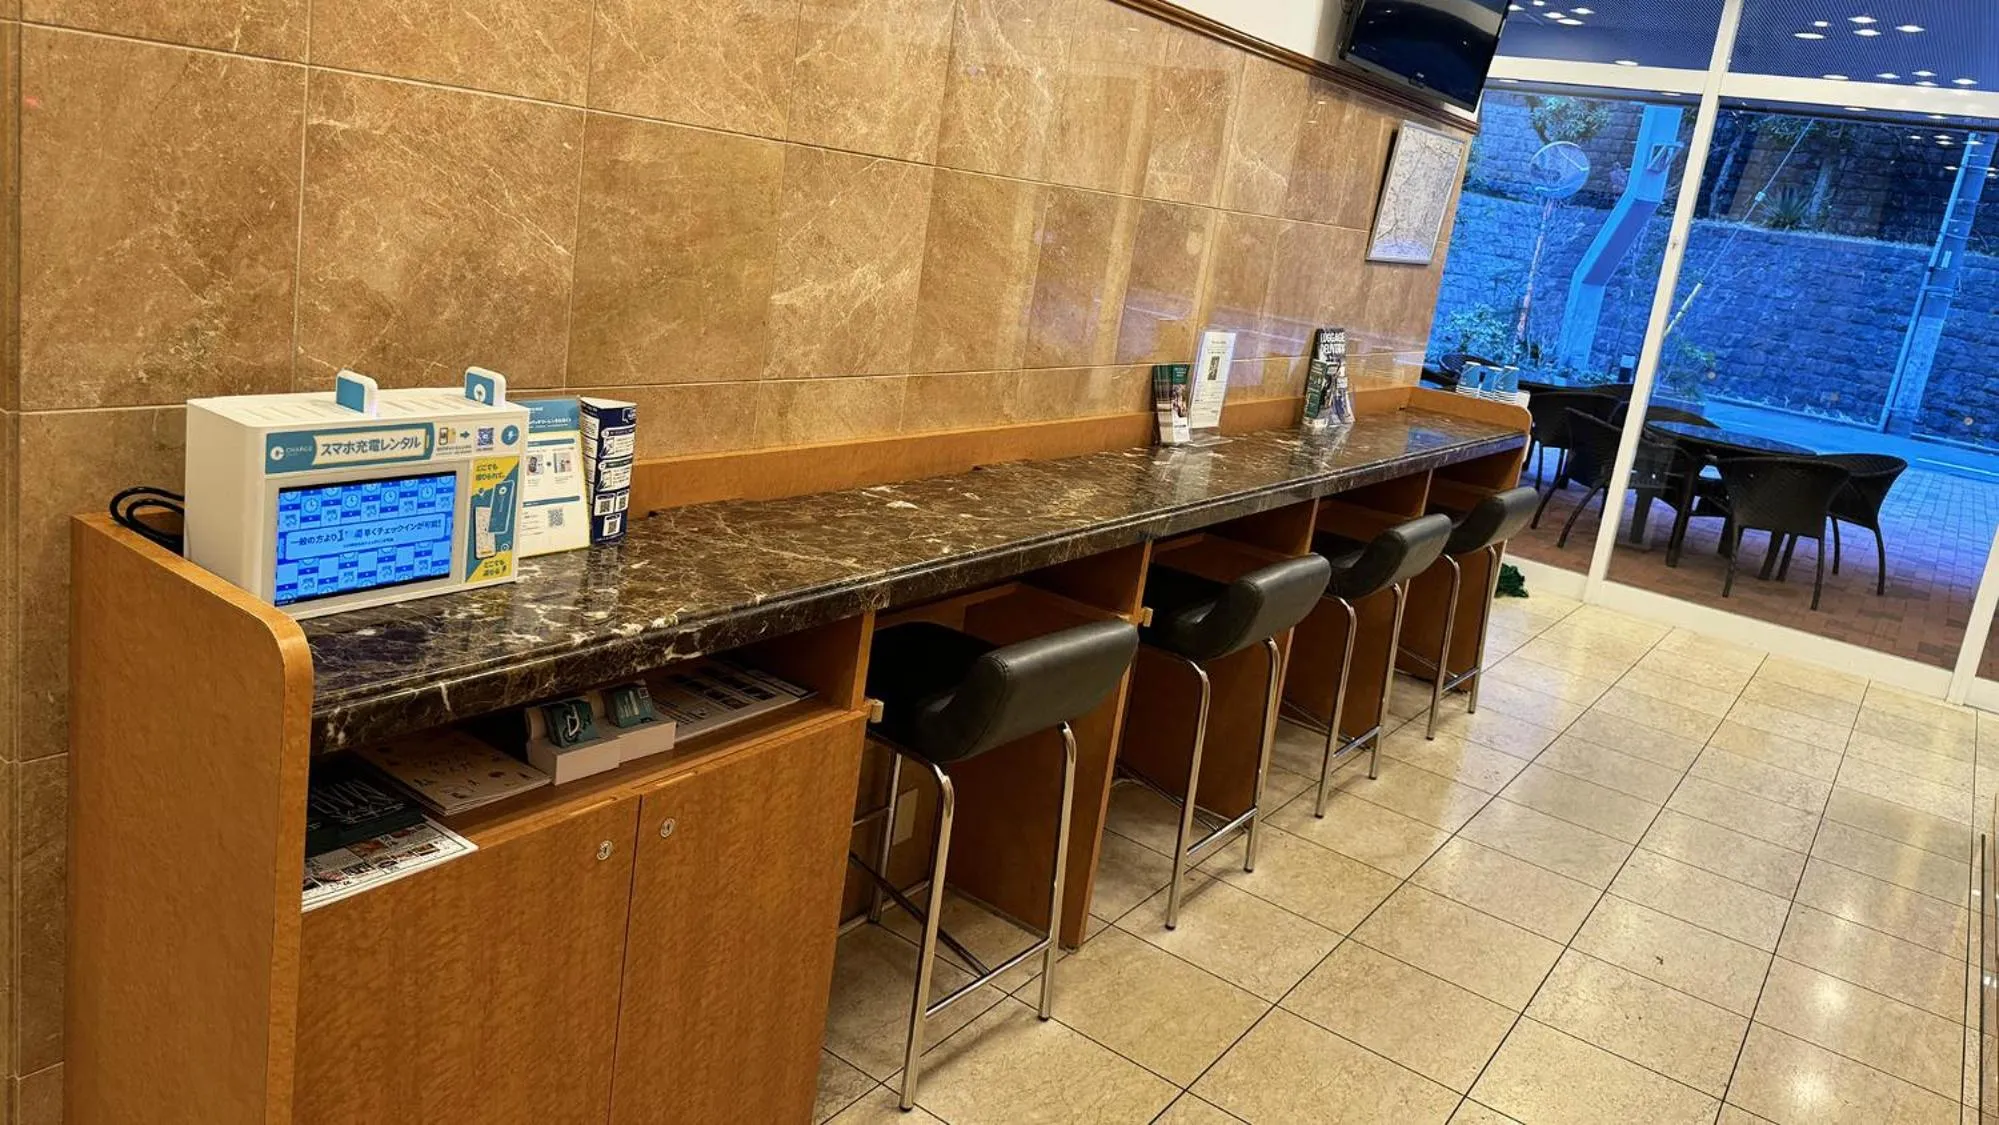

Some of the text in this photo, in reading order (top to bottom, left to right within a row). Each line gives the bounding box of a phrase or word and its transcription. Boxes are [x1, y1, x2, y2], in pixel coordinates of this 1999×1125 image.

[321, 437, 421, 456] スマホ充電レンタル
